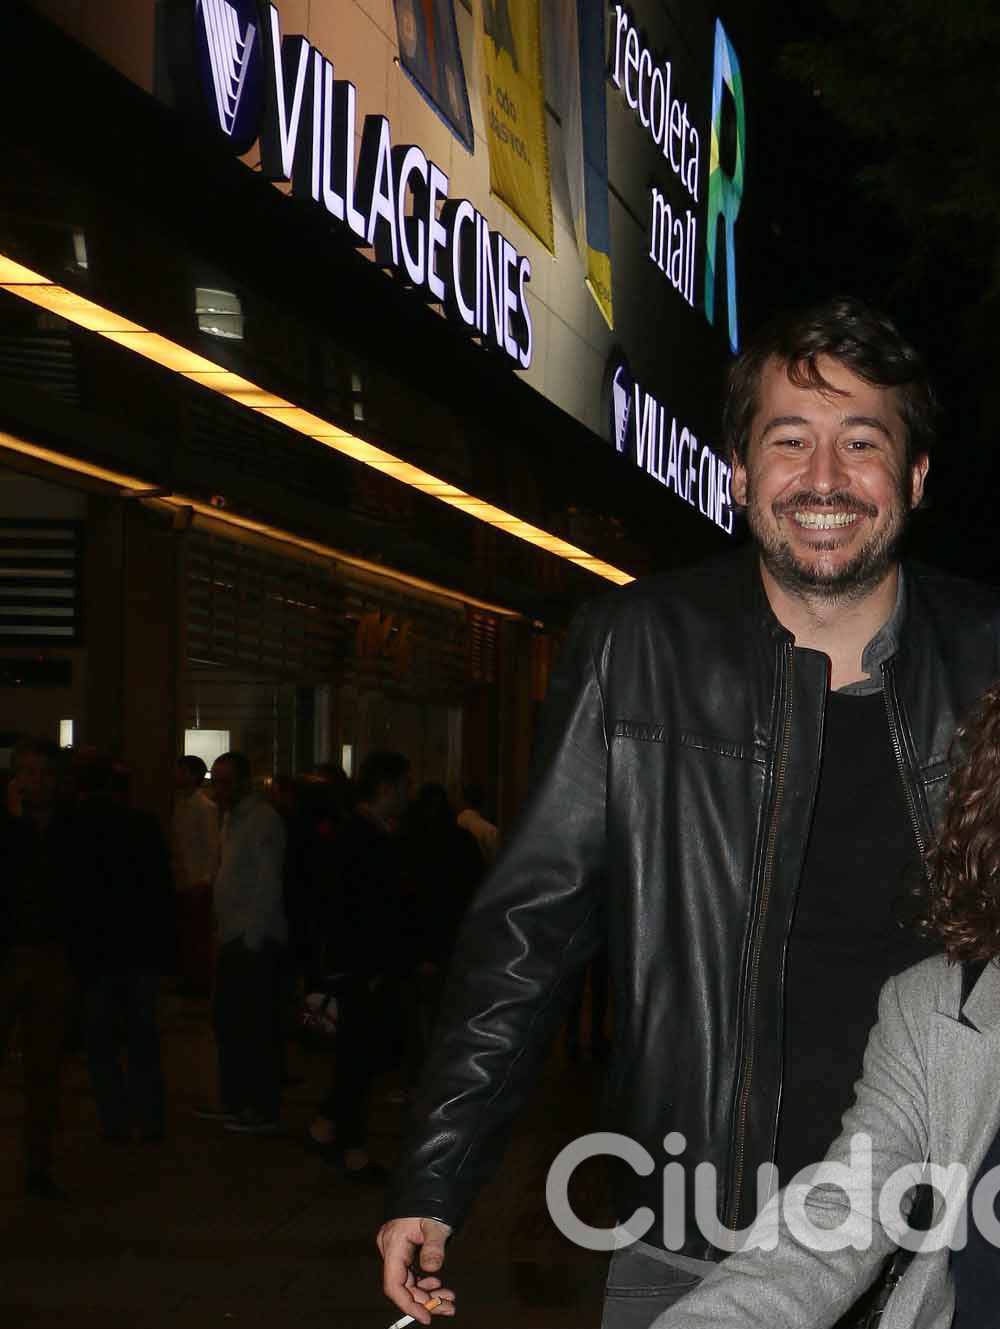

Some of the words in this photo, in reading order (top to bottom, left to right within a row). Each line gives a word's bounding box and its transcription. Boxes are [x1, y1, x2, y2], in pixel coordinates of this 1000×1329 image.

[270, 2, 449, 301] VILLAGE
[453, 200, 532, 369] CINES
[613, 5, 699, 202] recoleta
[650, 188, 696, 307] mall
[635, 383, 698, 506] VILLAGE
[700, 445, 733, 535] CINES
